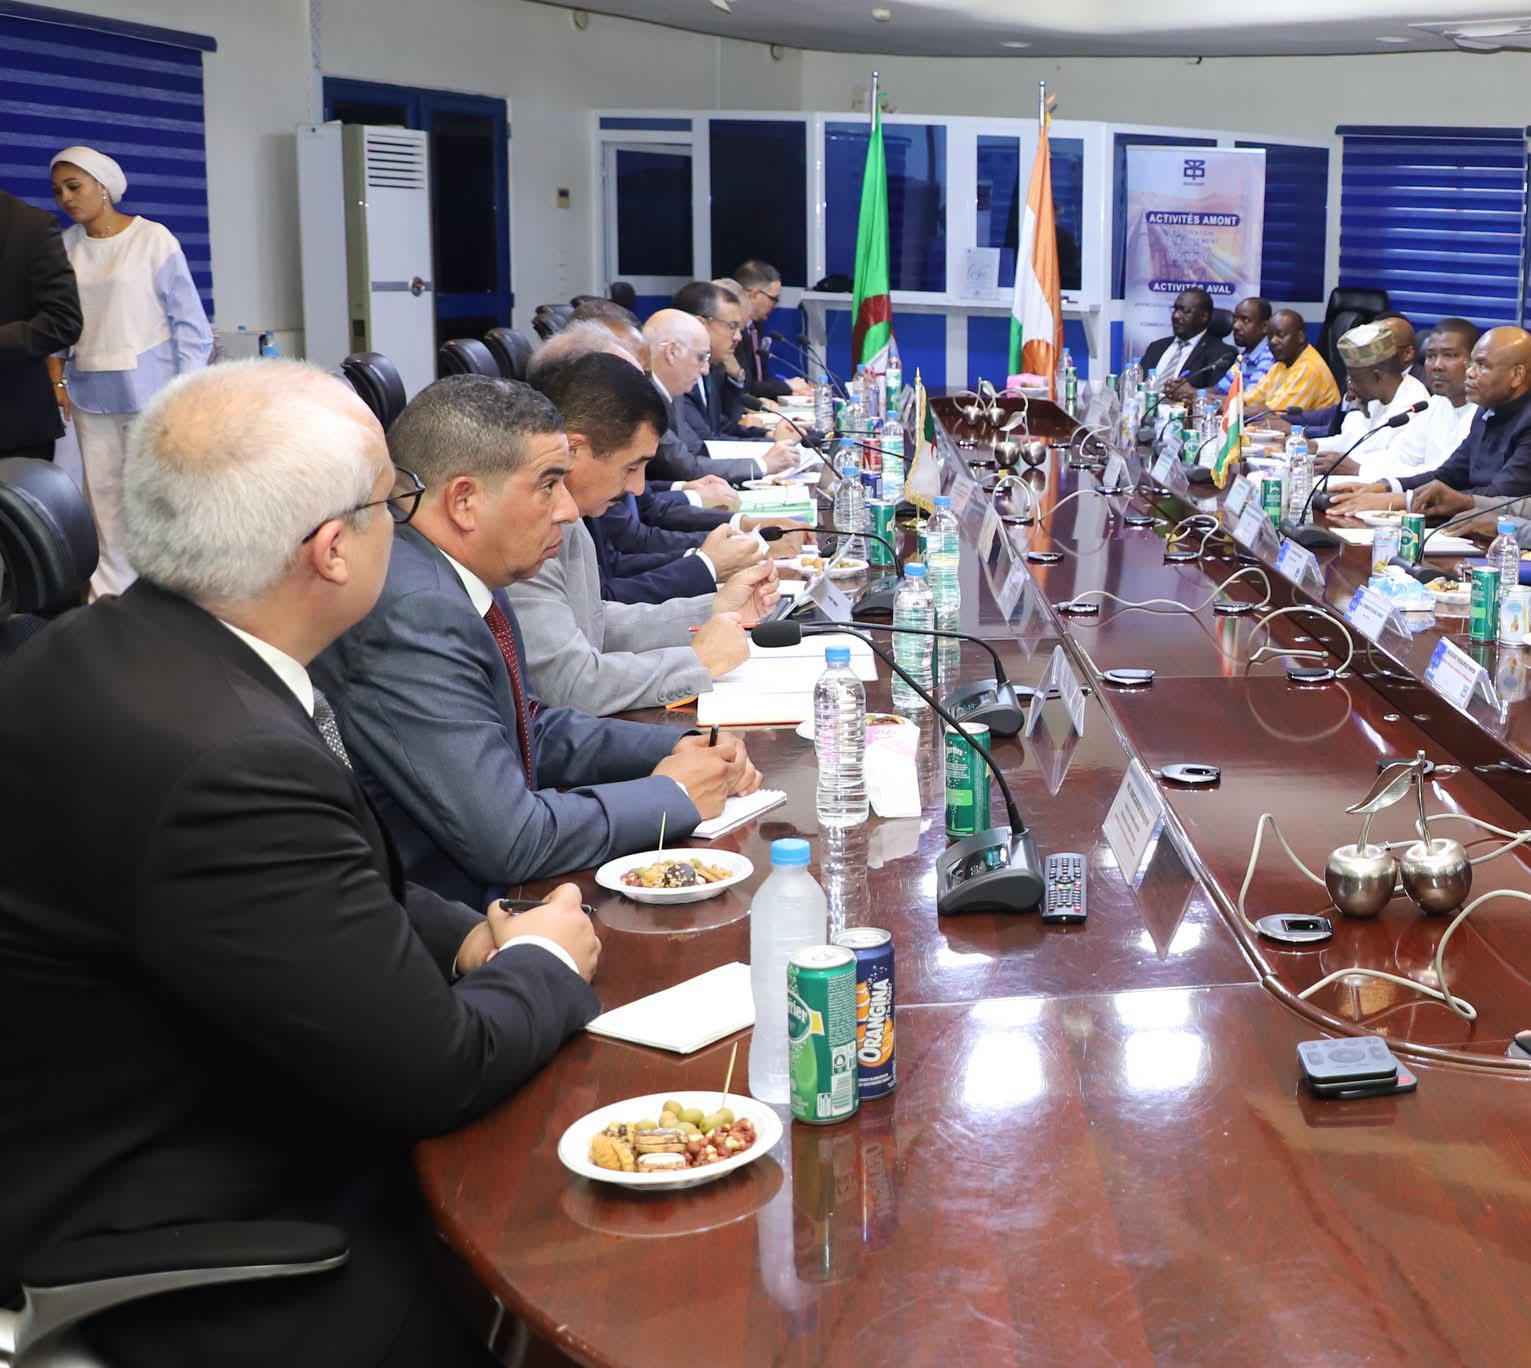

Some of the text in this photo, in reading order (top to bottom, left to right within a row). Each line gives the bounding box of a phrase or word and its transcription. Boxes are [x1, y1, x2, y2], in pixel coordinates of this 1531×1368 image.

[1149, 213, 1237, 225] ACTIVITÉS AMONT
[1206, 284, 1231, 294] AVAL
[858, 978, 889, 1063] ORANGINA
